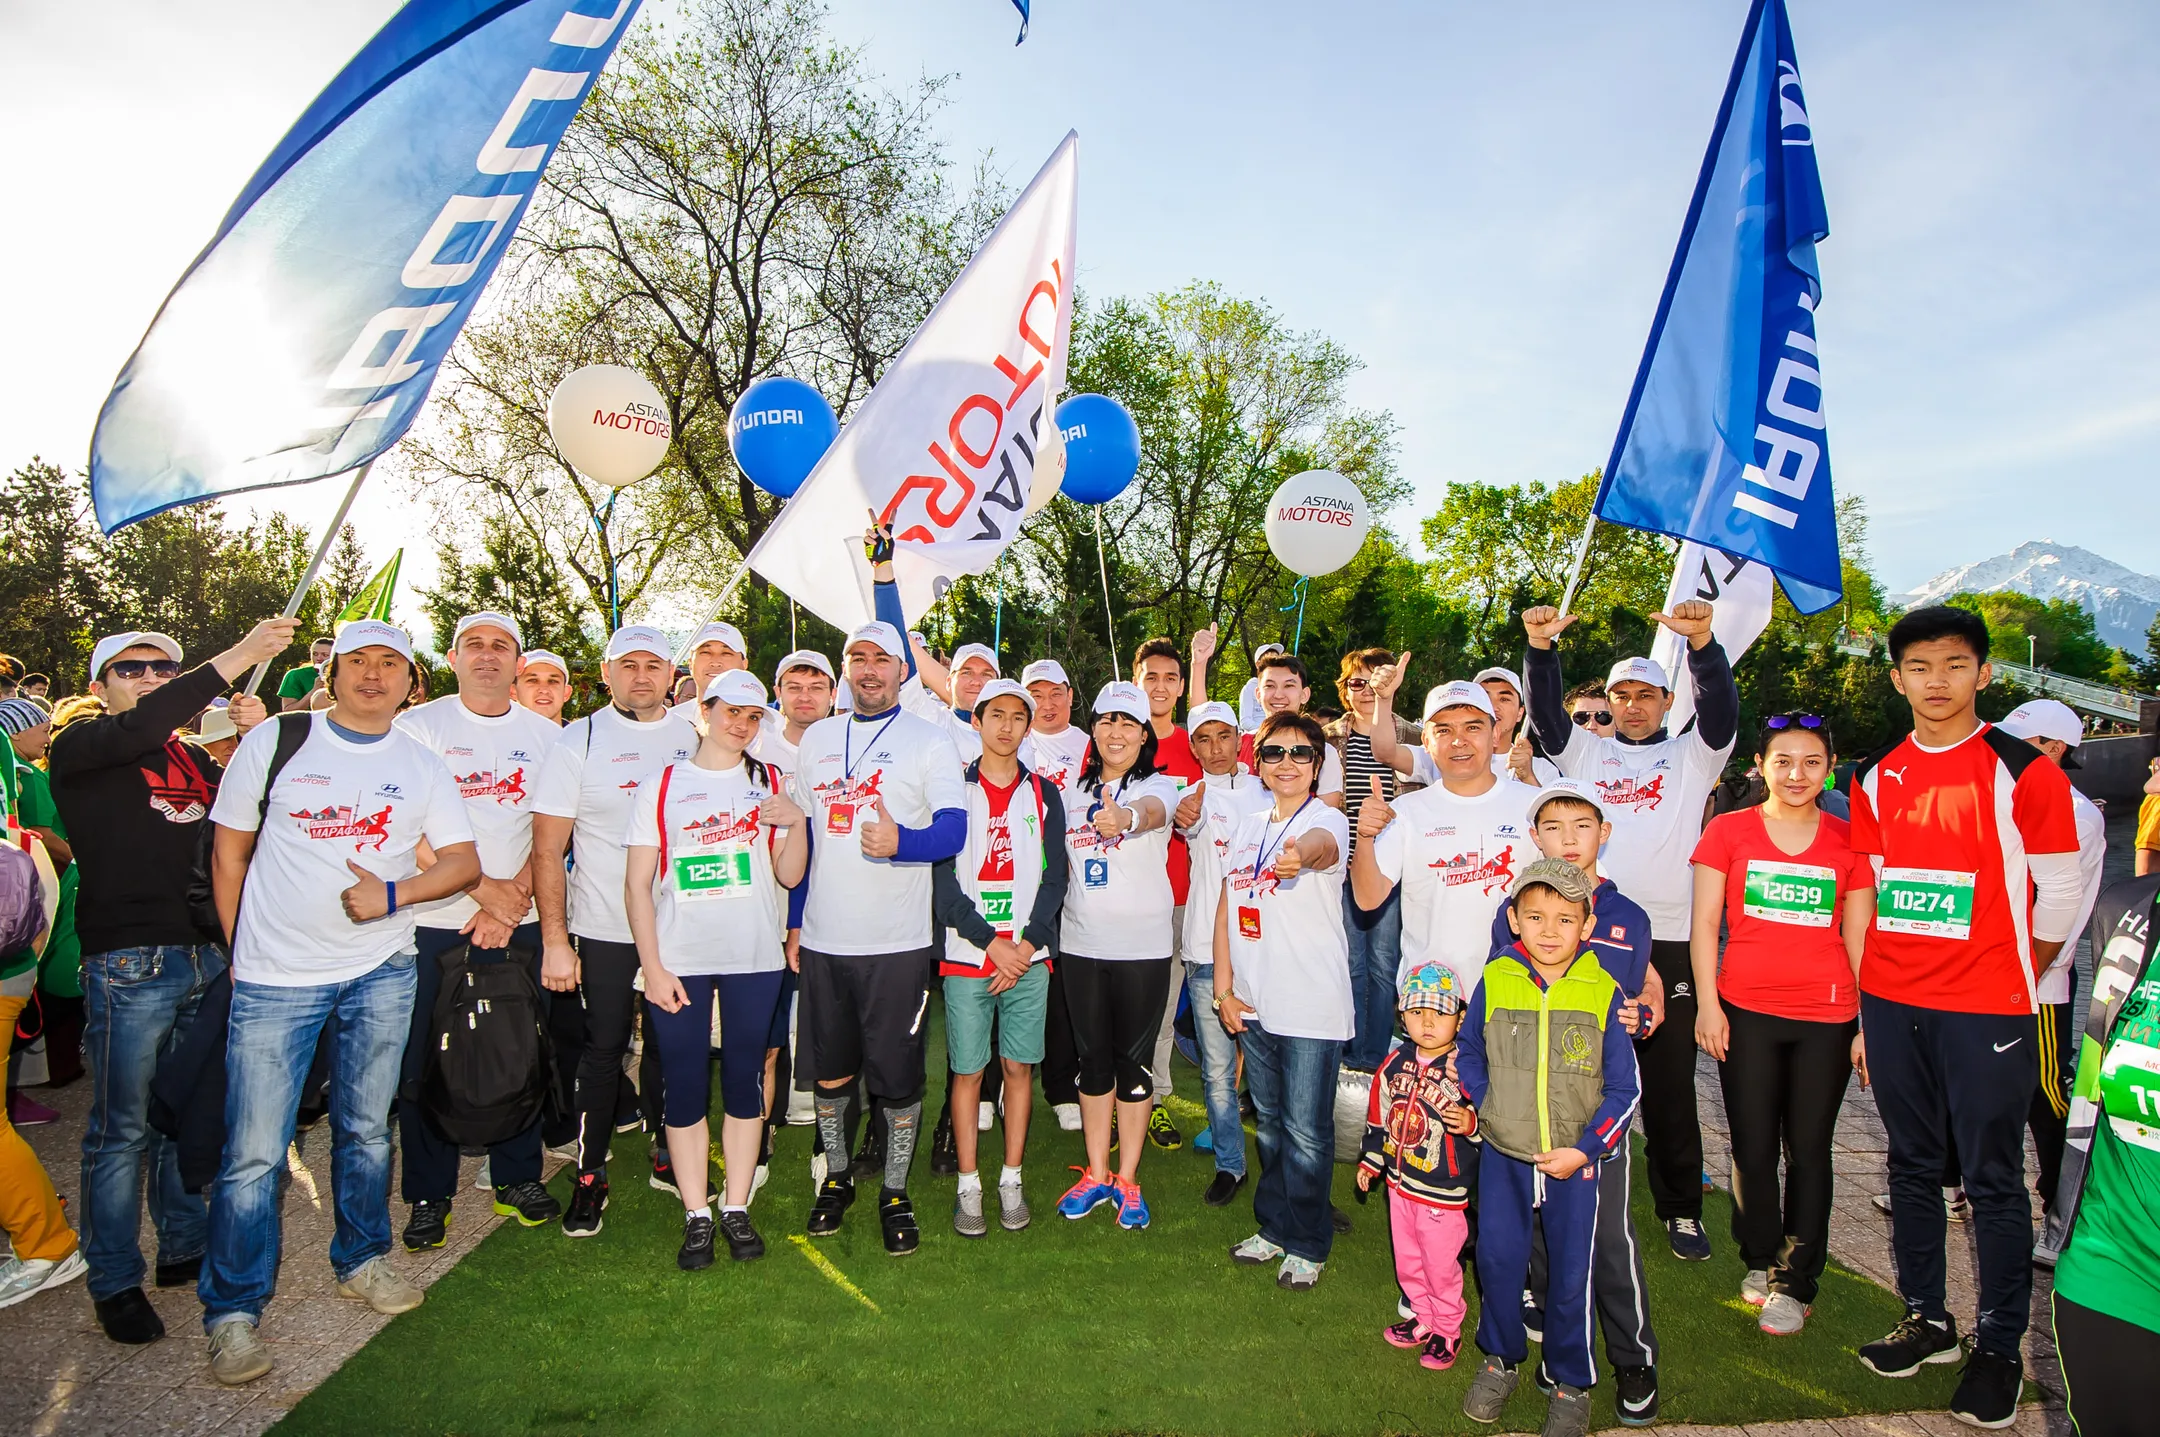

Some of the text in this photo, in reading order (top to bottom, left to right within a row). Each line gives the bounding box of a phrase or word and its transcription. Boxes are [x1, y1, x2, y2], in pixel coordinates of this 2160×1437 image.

[592, 409, 670, 439] MOTORS
[1302, 496, 1354, 513] ASTANA
[1278, 507, 1353, 527] MOTORS
[291, 777, 330, 786] MOTORS
[374, 791, 404, 800] HYUNDAI
[462, 786, 508, 797] МАРАФОН
[1604, 793, 1646, 804] МАРАФОН
[311, 825, 368, 838] МАРАФОН
[703, 825, 747, 844] МАРАФОН
[1447, 868, 1495, 885] МАРАФОН
[1761, 881, 1822, 905] 12639
[1891, 890, 1955, 914] 10274
